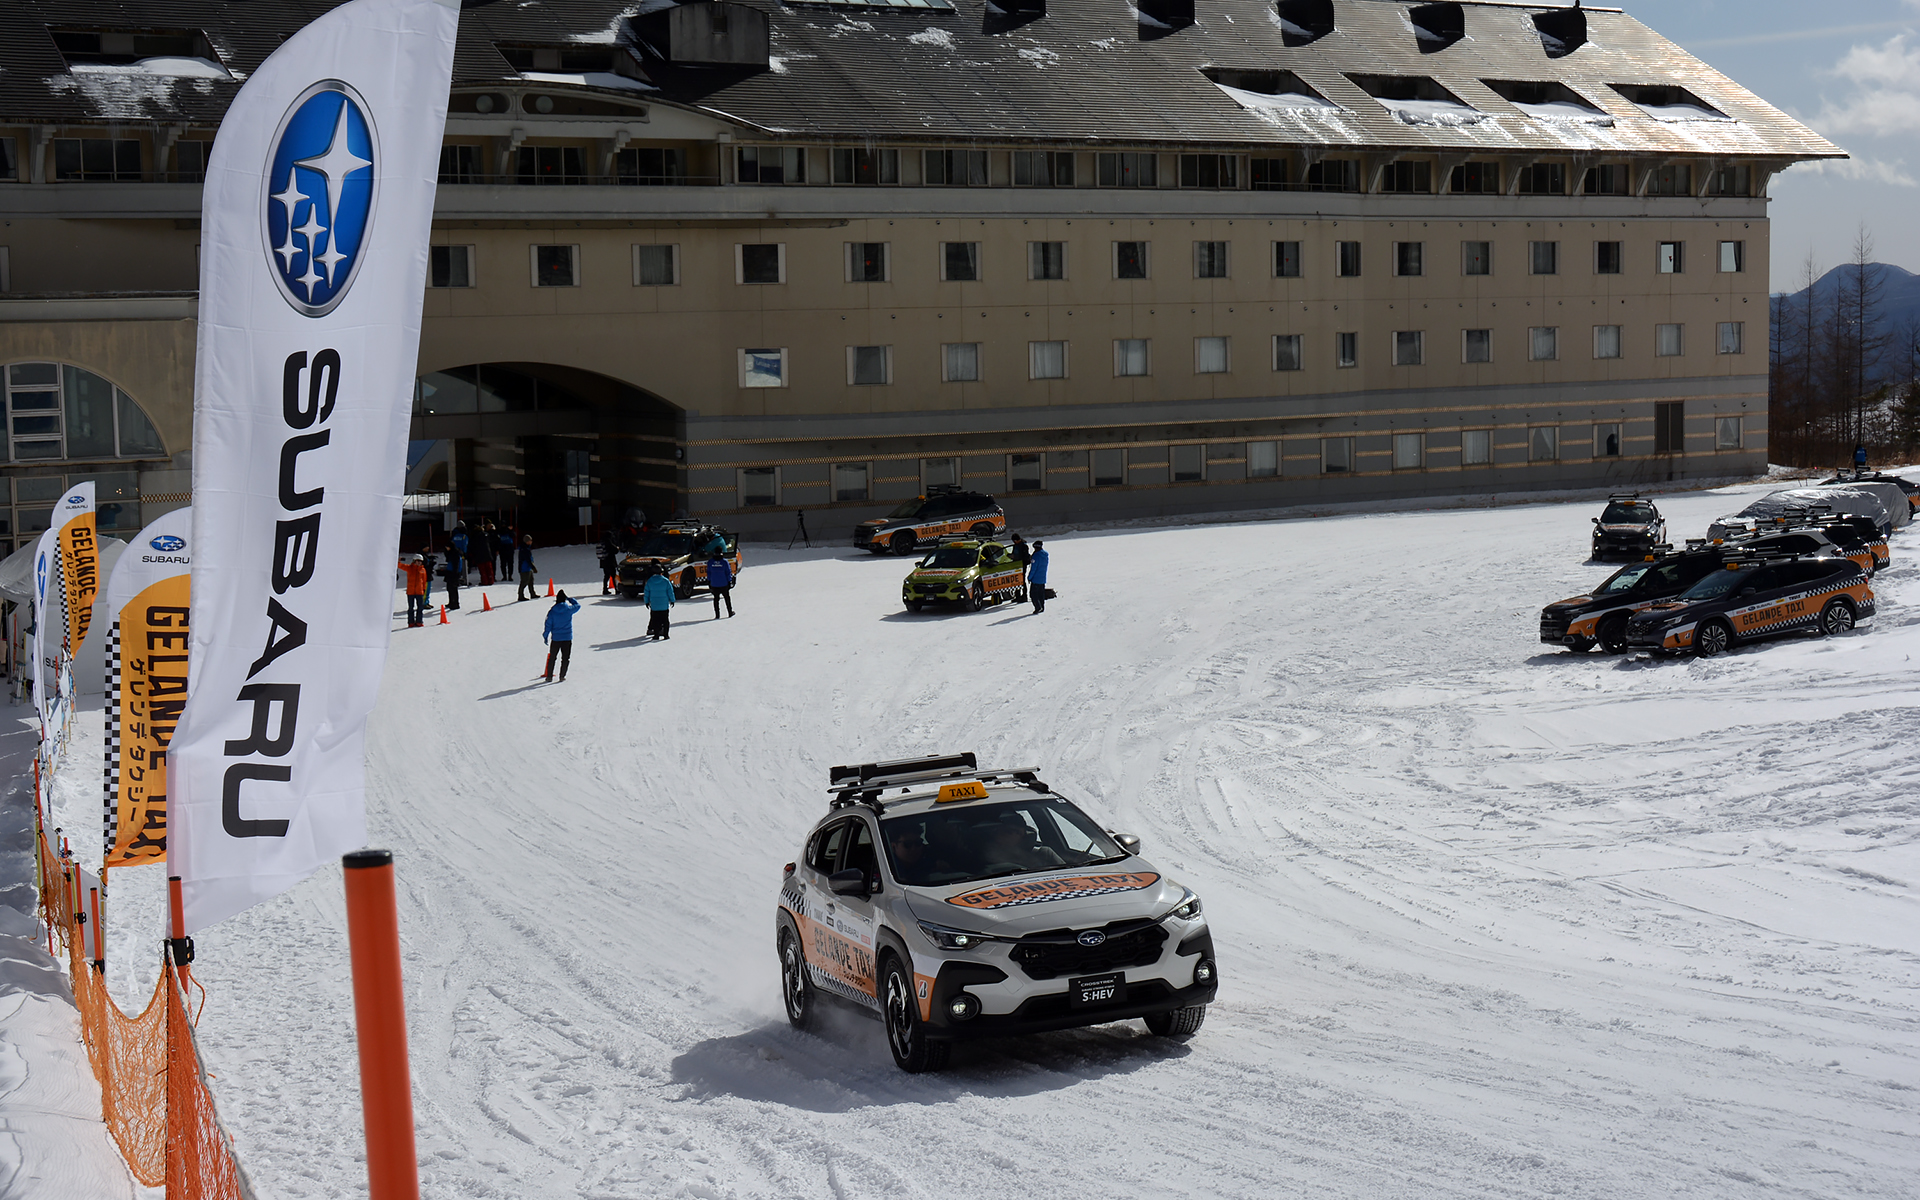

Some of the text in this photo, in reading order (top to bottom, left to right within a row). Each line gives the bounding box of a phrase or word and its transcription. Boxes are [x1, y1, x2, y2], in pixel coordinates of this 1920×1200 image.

[71, 527, 96, 600] GELANDE
[142, 555, 190, 564] SUBARU
[222, 348, 341, 838] SUBARU
[987, 574, 1019, 588] GELANDE
[1743, 606, 1782, 626] GELANDE
[1785, 600, 1805, 614] TAXI
[128, 658, 147, 822] ゲレンデタクシー
[948, 786, 976, 798] TAXI
[961, 878, 1078, 906] GELANDE
[1087, 873, 1146, 885] TAXI
[814, 926, 853, 972] GELANDE
[1082, 988, 1115, 1002] S:HEV
